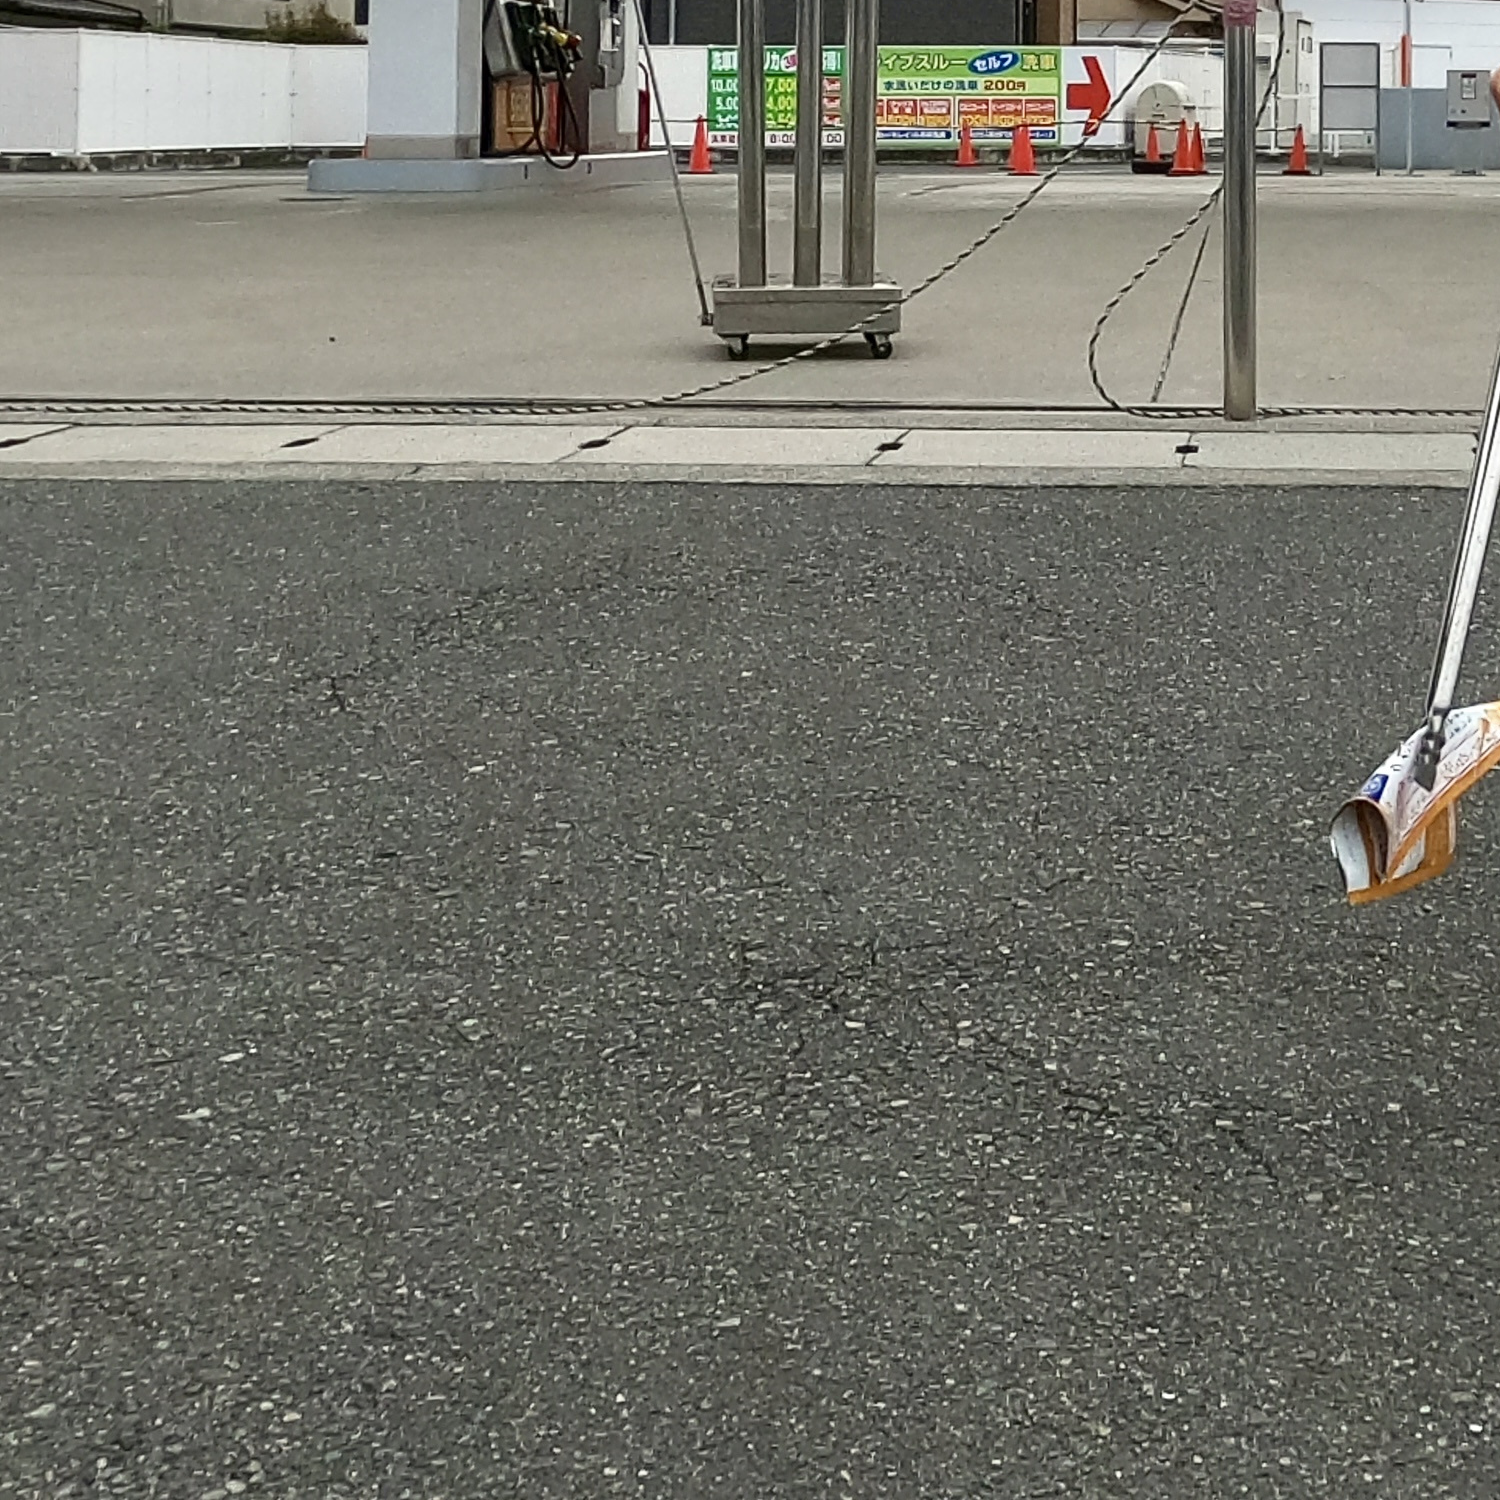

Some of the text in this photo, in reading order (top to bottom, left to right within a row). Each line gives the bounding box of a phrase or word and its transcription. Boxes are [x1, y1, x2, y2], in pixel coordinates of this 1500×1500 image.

[878, 52, 967, 71] イブスルー
[973, 53, 1013, 72] セルフ
